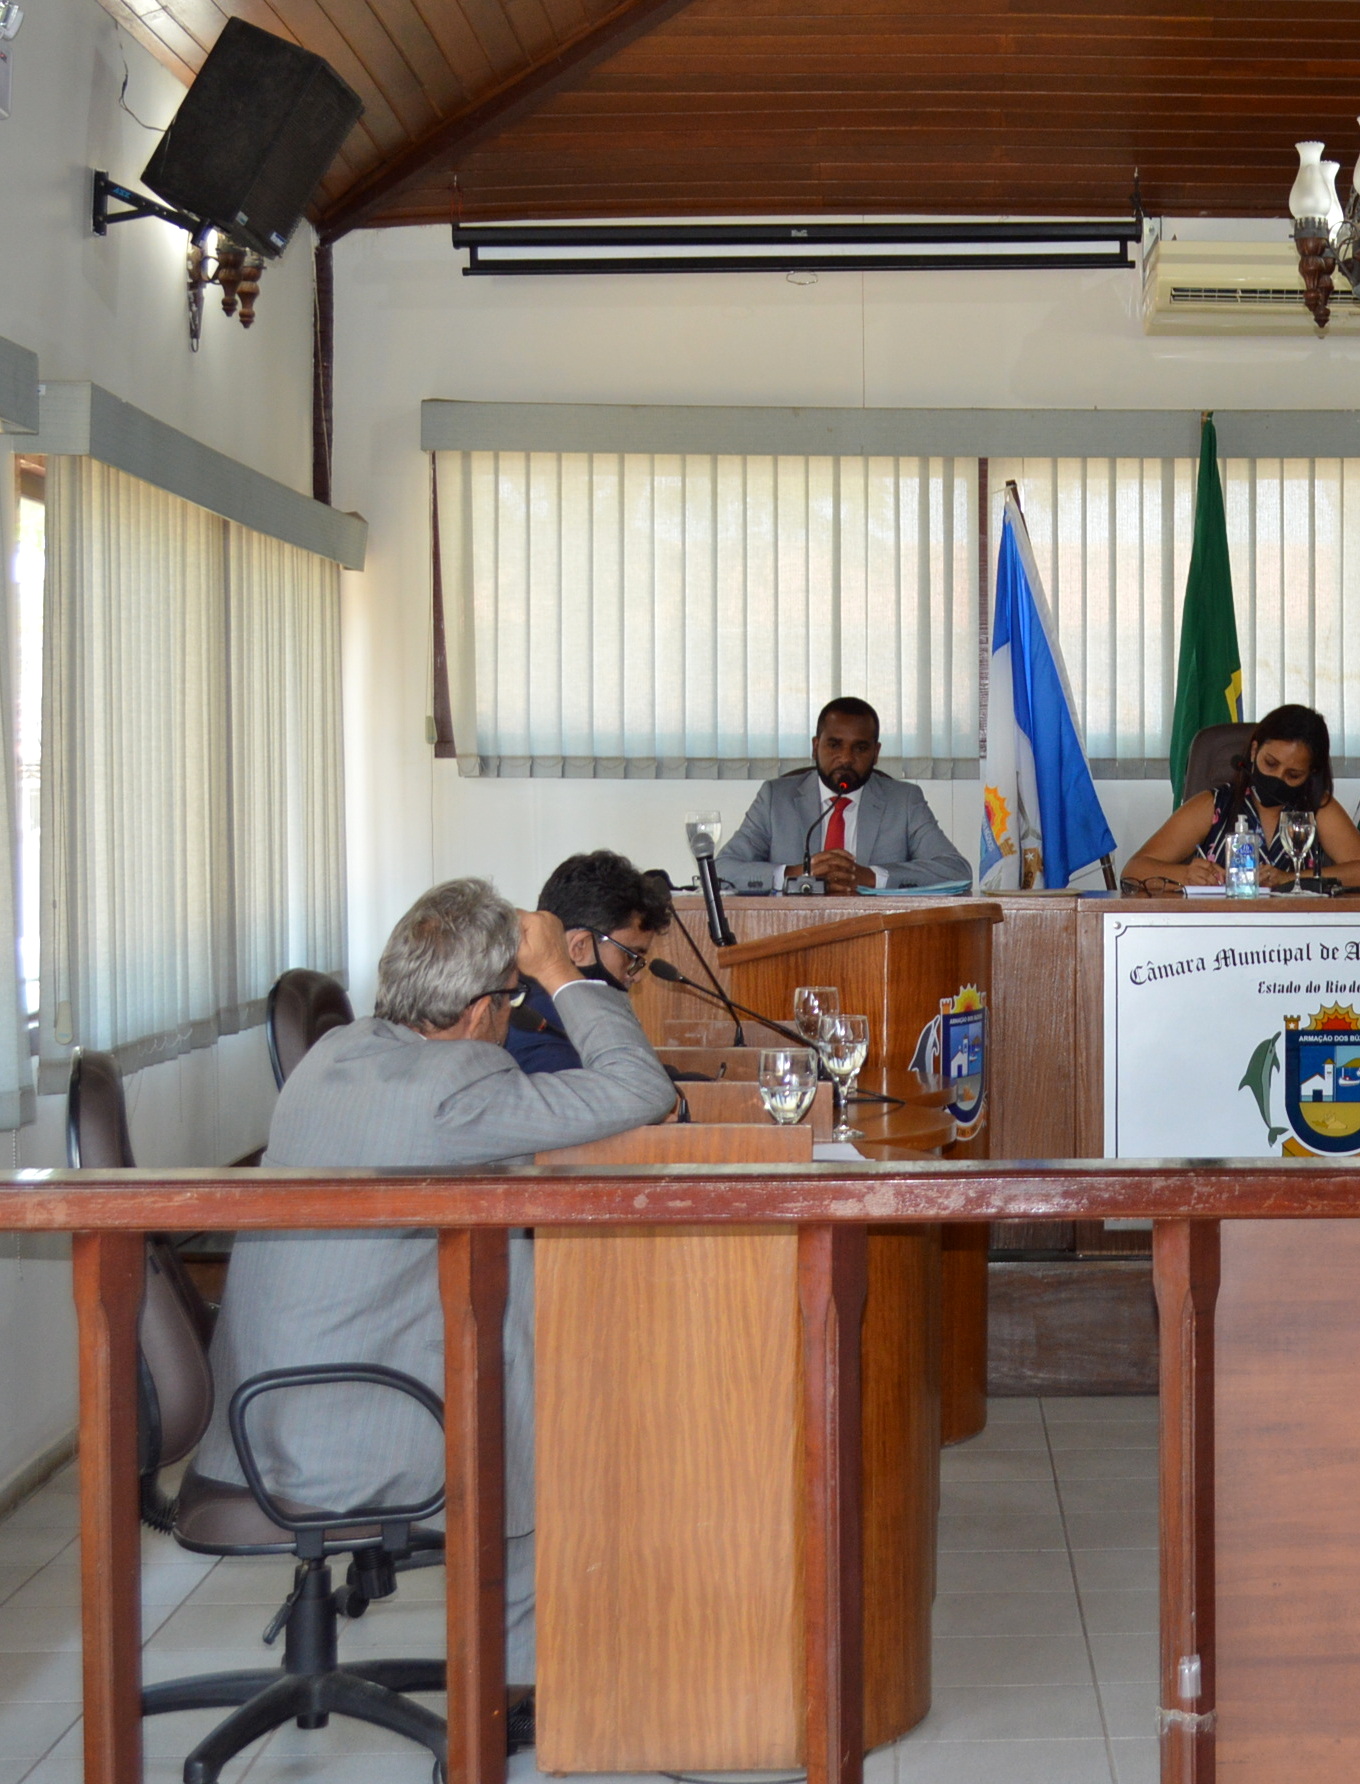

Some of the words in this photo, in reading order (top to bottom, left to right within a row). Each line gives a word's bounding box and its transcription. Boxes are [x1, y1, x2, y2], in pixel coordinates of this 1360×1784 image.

[1129, 956, 1206, 986] Câmara
[1213, 942, 1312, 972] Municipal
[1319, 942, 1340, 961] de
[1257, 980, 1301, 994] Estado
[1305, 980, 1321, 994] do
[1325, 980, 1347, 994] Rio
[1298, 1034, 1333, 1043] ARMAÇÃO
[1334, 1034, 1349, 1042] DOS
